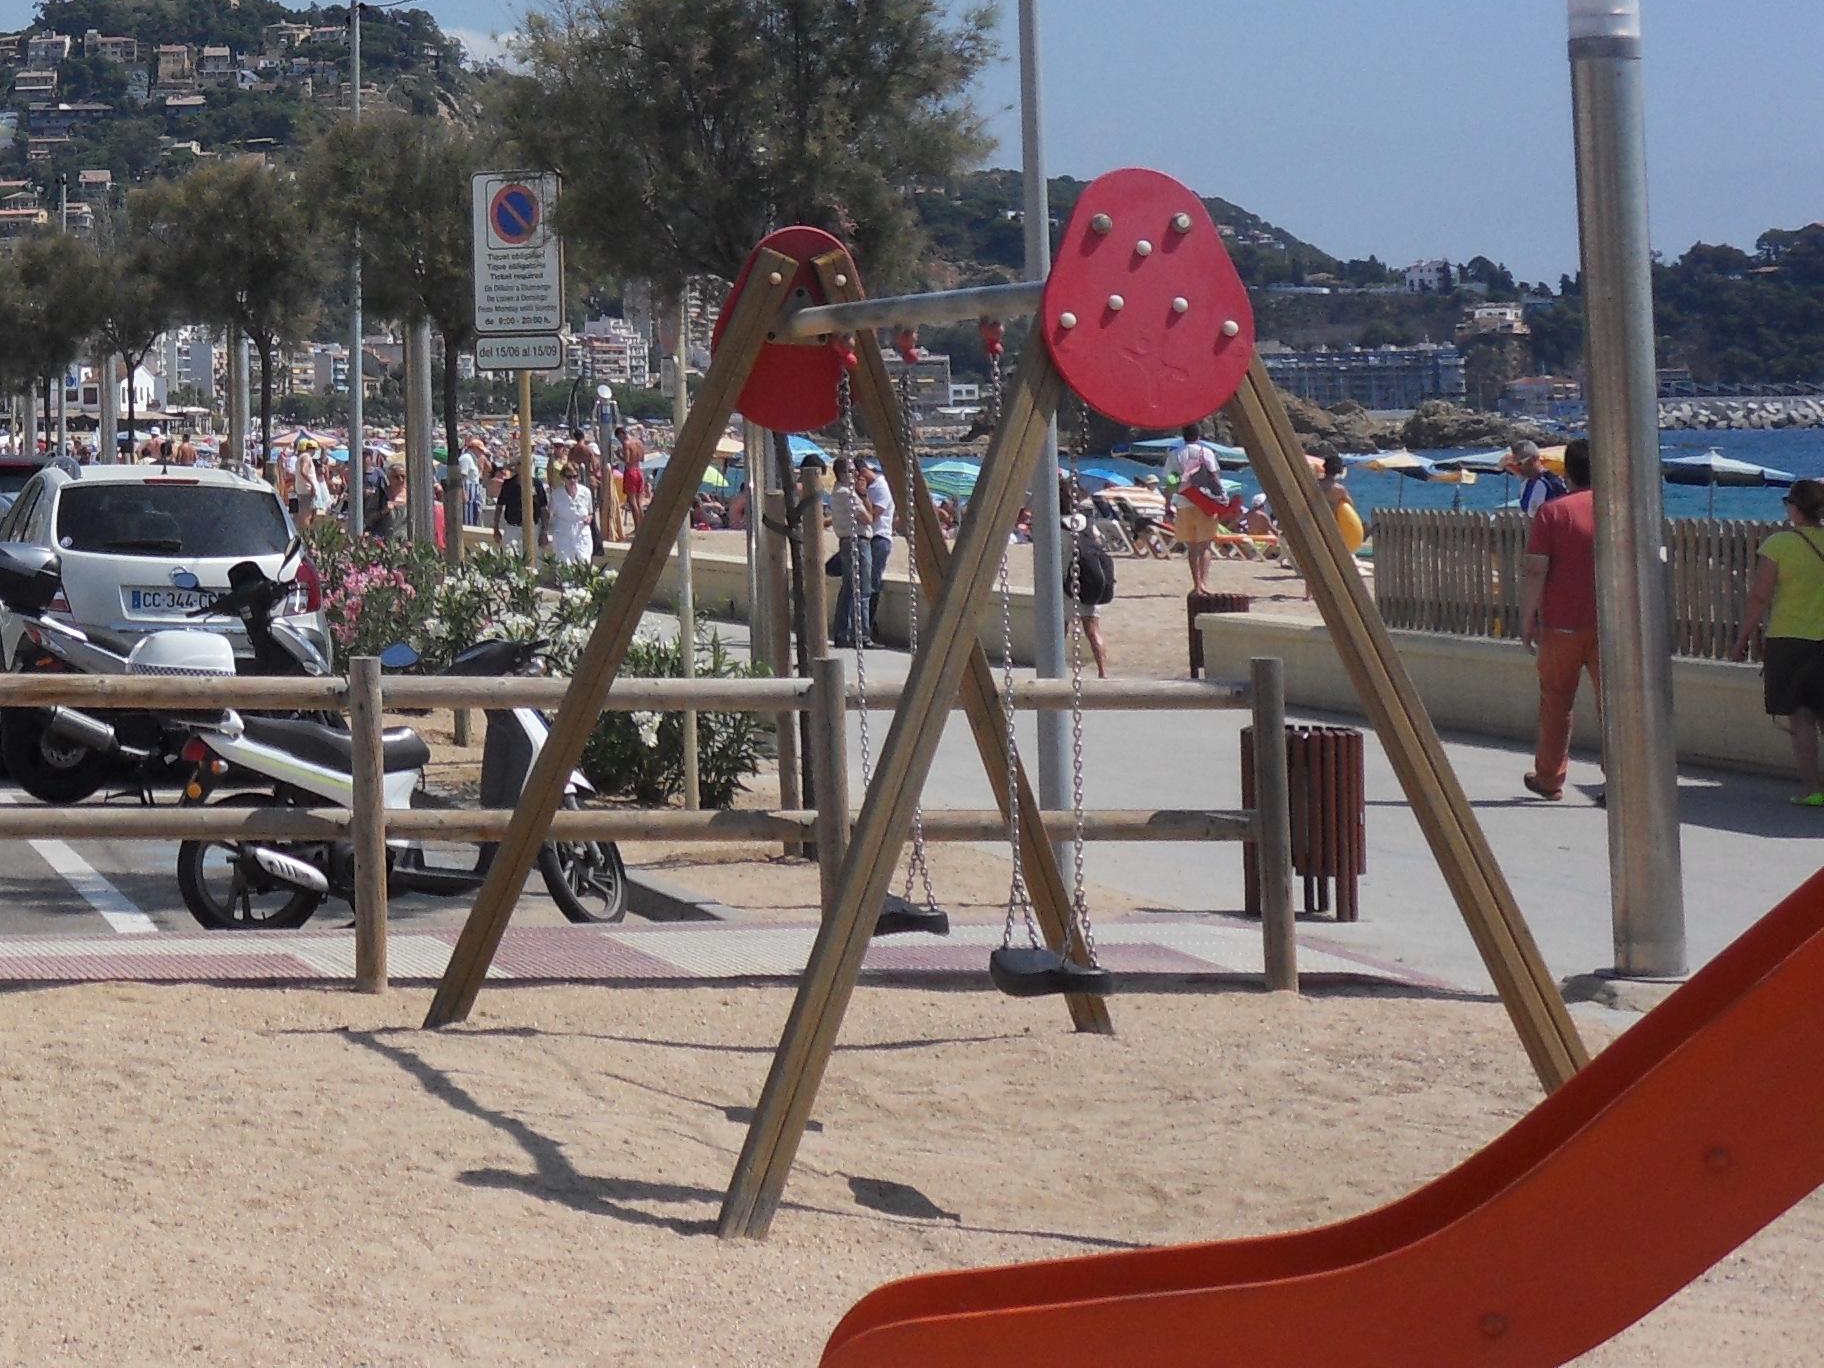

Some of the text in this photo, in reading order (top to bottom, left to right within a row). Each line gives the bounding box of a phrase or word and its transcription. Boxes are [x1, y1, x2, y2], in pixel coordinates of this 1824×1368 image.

[513, 273, 544, 281] required
[495, 305, 518, 313] Monday
[479, 345, 557, 358] del 15/06 al 15/09
[142, 592, 223, 608] CC-344-C
